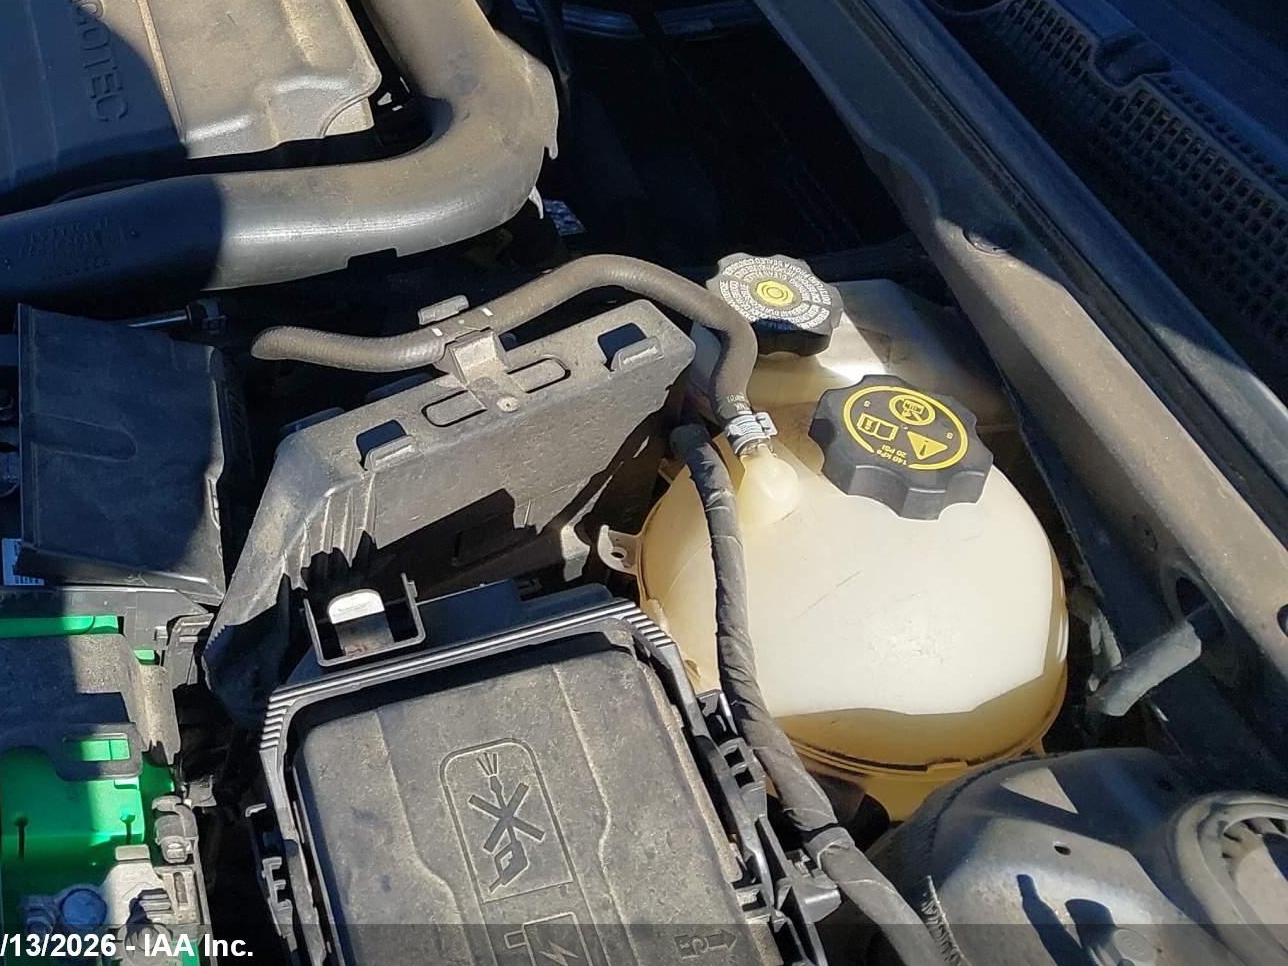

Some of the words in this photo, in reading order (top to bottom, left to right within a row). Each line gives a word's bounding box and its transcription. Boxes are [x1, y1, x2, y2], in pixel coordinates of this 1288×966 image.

[881, 444, 895, 454] PSI
[876, 450, 892, 460] kPa
[892, 456, 907, 465] 140
